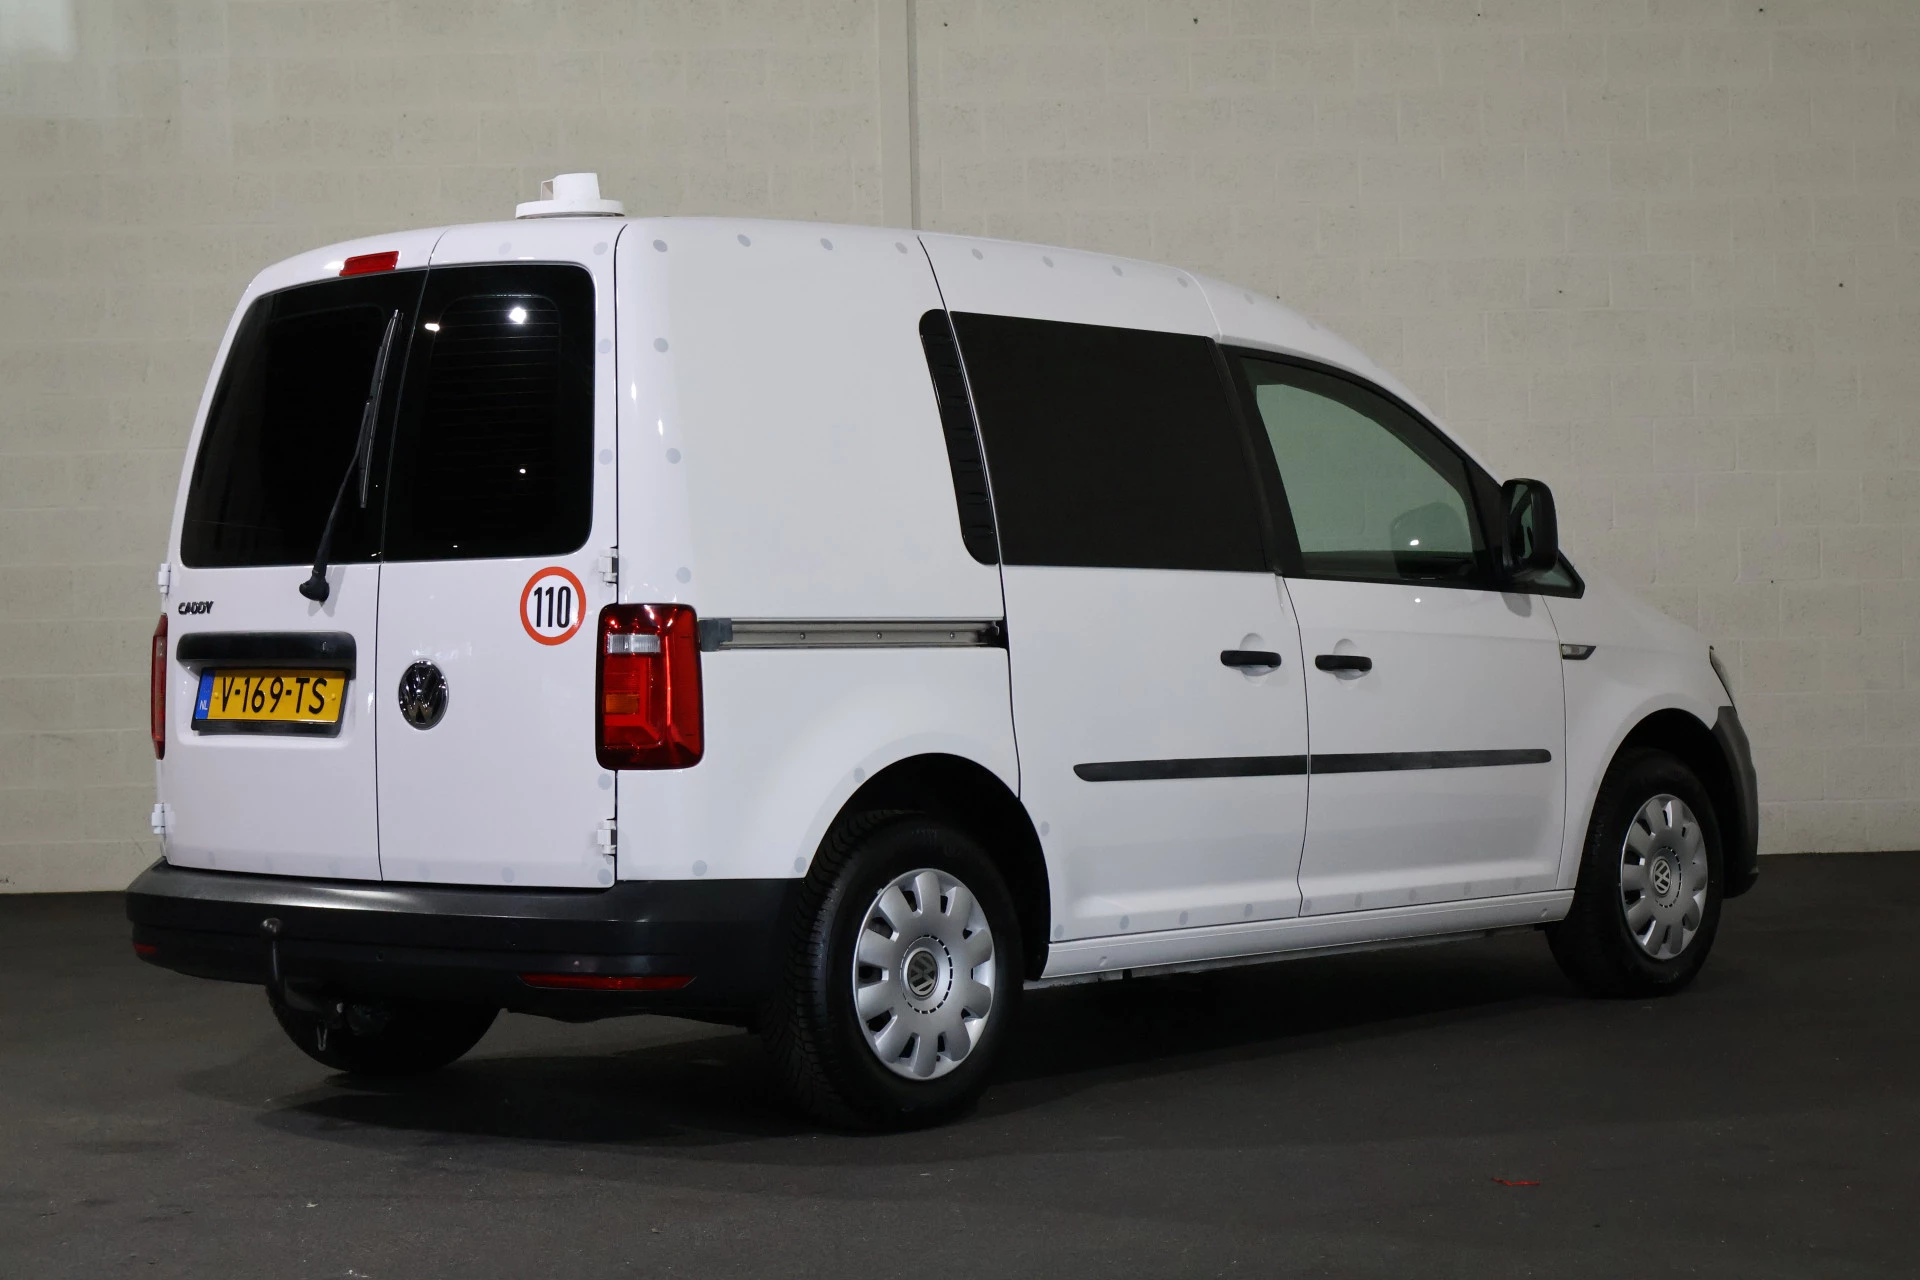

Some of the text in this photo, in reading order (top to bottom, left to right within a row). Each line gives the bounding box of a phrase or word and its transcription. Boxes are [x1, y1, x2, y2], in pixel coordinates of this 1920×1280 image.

[178, 601, 214, 615] CADDY
[533, 586, 572, 628] 110
[199, 699, 208, 711] NL
[222, 677, 327, 714] V-169-TS
